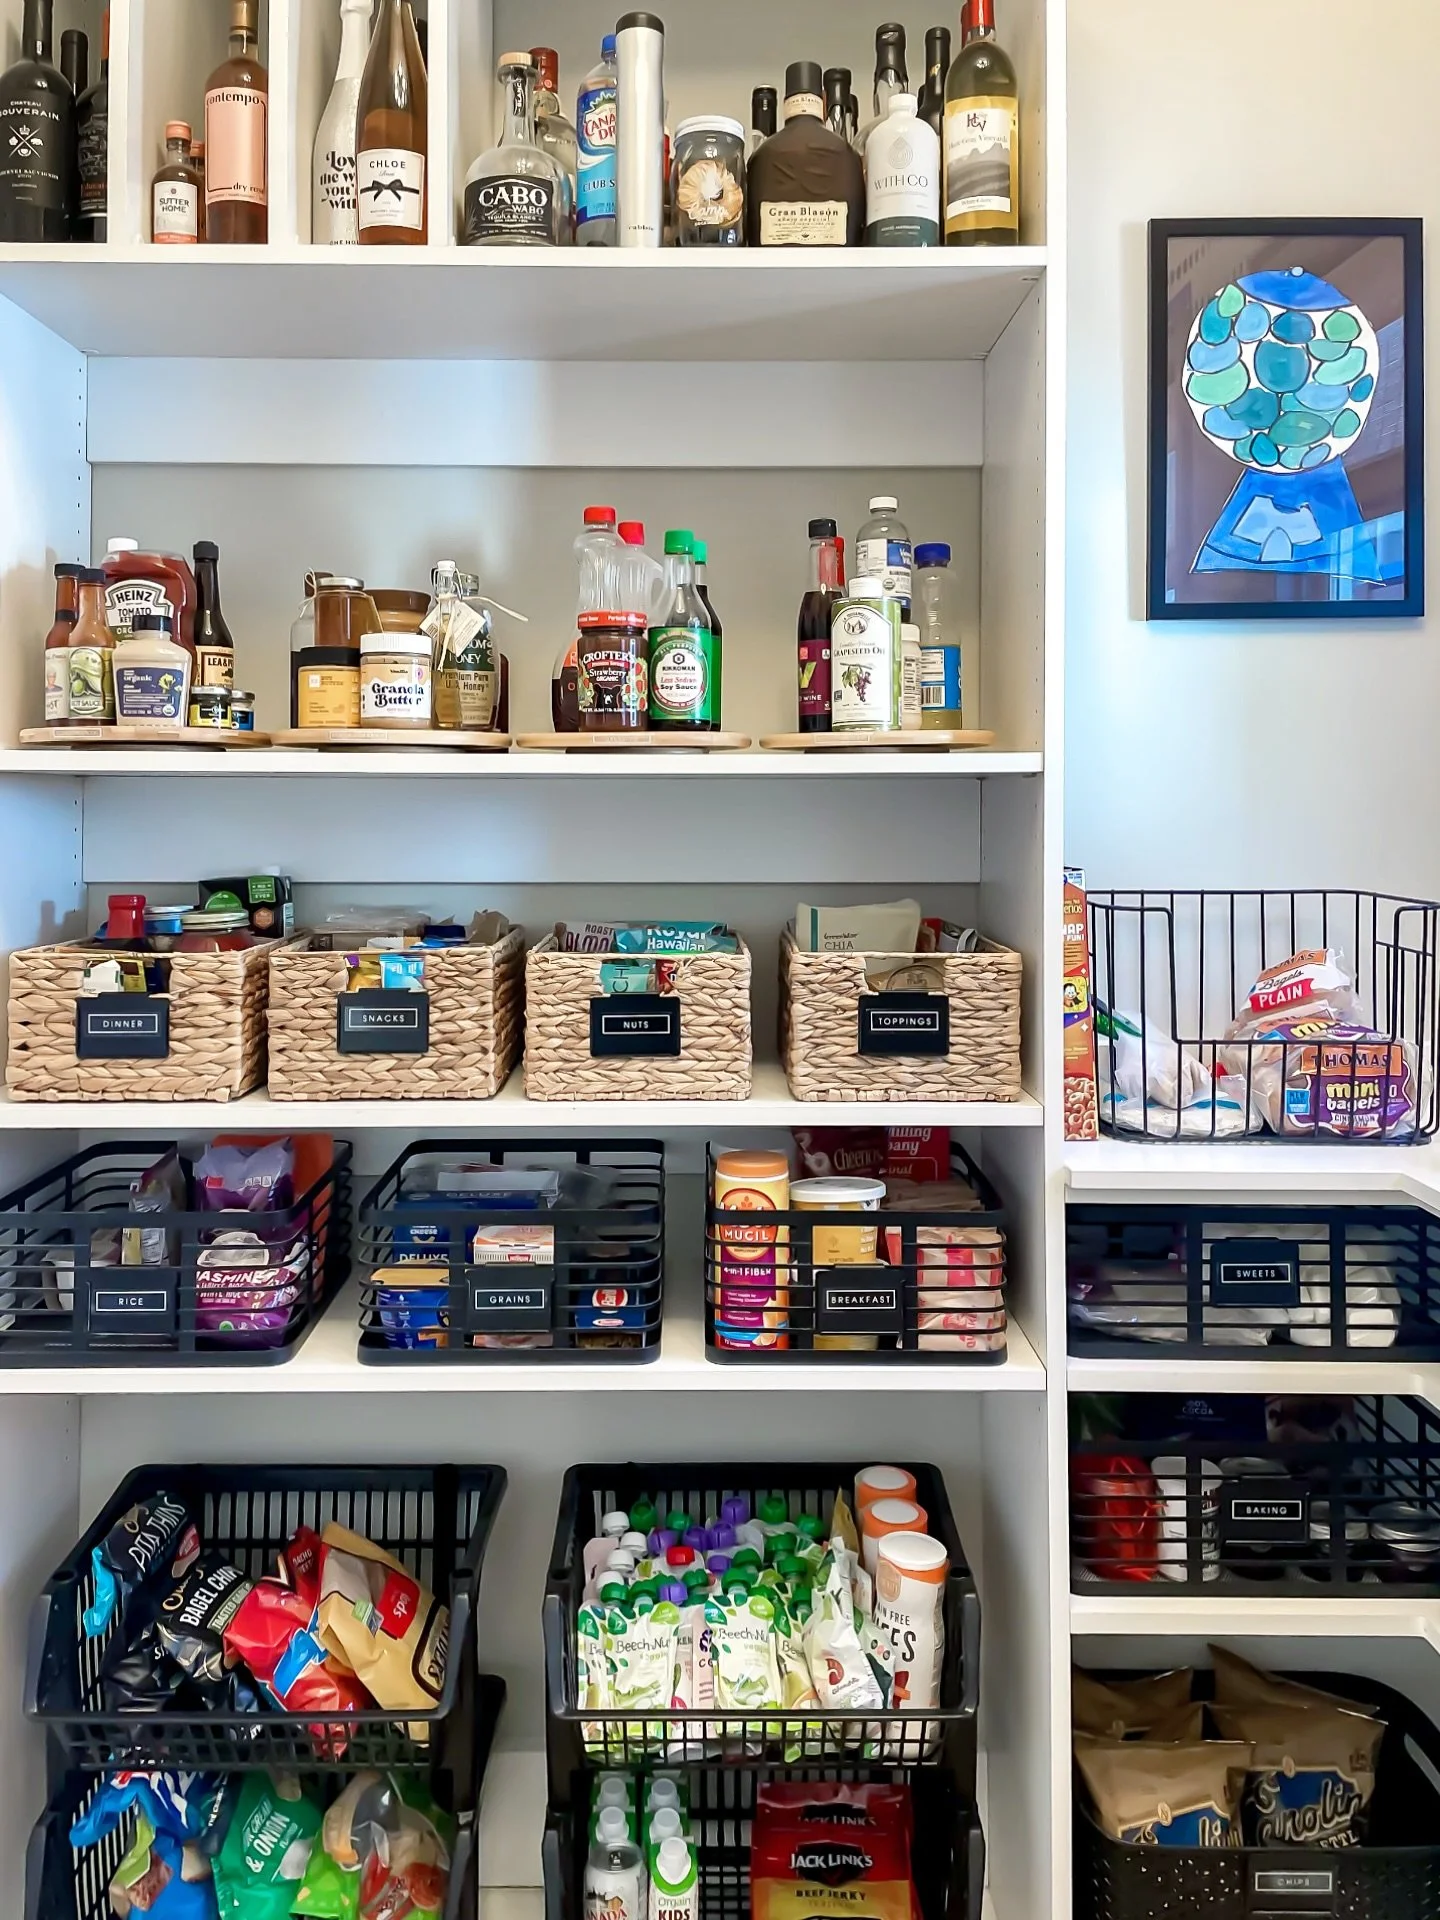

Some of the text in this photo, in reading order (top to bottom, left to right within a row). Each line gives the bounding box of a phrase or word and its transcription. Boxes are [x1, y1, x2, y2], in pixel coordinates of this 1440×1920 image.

[584, 112, 616, 137] CANA
[598, 128, 616, 141] DR
[326, 151, 357, 172] Lov
[369, 160, 407, 169] CHLOE
[325, 183, 355, 197] you'
[583, 180, 606, 193] CLUB
[160, 197, 190, 207] SUTTER
[478, 186, 548, 208] CABO
[161, 204, 187, 214] HOME
[512, 205, 545, 216] WABO
[768, 207, 797, 217] Gran
[116, 590, 153, 603] HEINZ
[117, 608, 152, 617] TOMATO
[589, 668, 627, 680] Strawberry
[371, 682, 424, 695] Granola
[374, 693, 422, 708] Butter
[1064, 923, 1084, 935] AP
[647, 938, 705, 952] Hawaiian
[824, 941, 854, 950] CHIA
[1258, 968, 1305, 991] Bagels
[1258, 985, 1304, 1009] PLAIN
[102, 1019, 144, 1028] DINNER
[362, 1014, 405, 1022] SNACKS
[878, 1017, 932, 1025] TOPPINGS
[623, 1020, 649, 1029] NUTS
[1326, 1079, 1381, 1099] mini
[724, 1229, 769, 1241] MUCIL
[1236, 1269, 1276, 1278] SWEETS
[118, 1296, 144, 1307] RICE
[489, 1295, 531, 1304] GRAINS
[831, 1295, 892, 1304] BREAKFAST
[1246, 1505, 1288, 1515] BAKING
[179, 1587, 219, 1627] BAGEL
[890, 1610, 911, 1626] FREE
[253, 1811, 290, 1856] ONION
[1319, 1829, 1361, 1849] ETTL
[788, 1853, 827, 1869] JACK
[1277, 1878, 1310, 1887] CHIPS
[795, 1889, 866, 1901] BEEF JERKY
[658, 1897, 691, 1908] Orgain
[658, 1908, 691, 1920] KIDS
